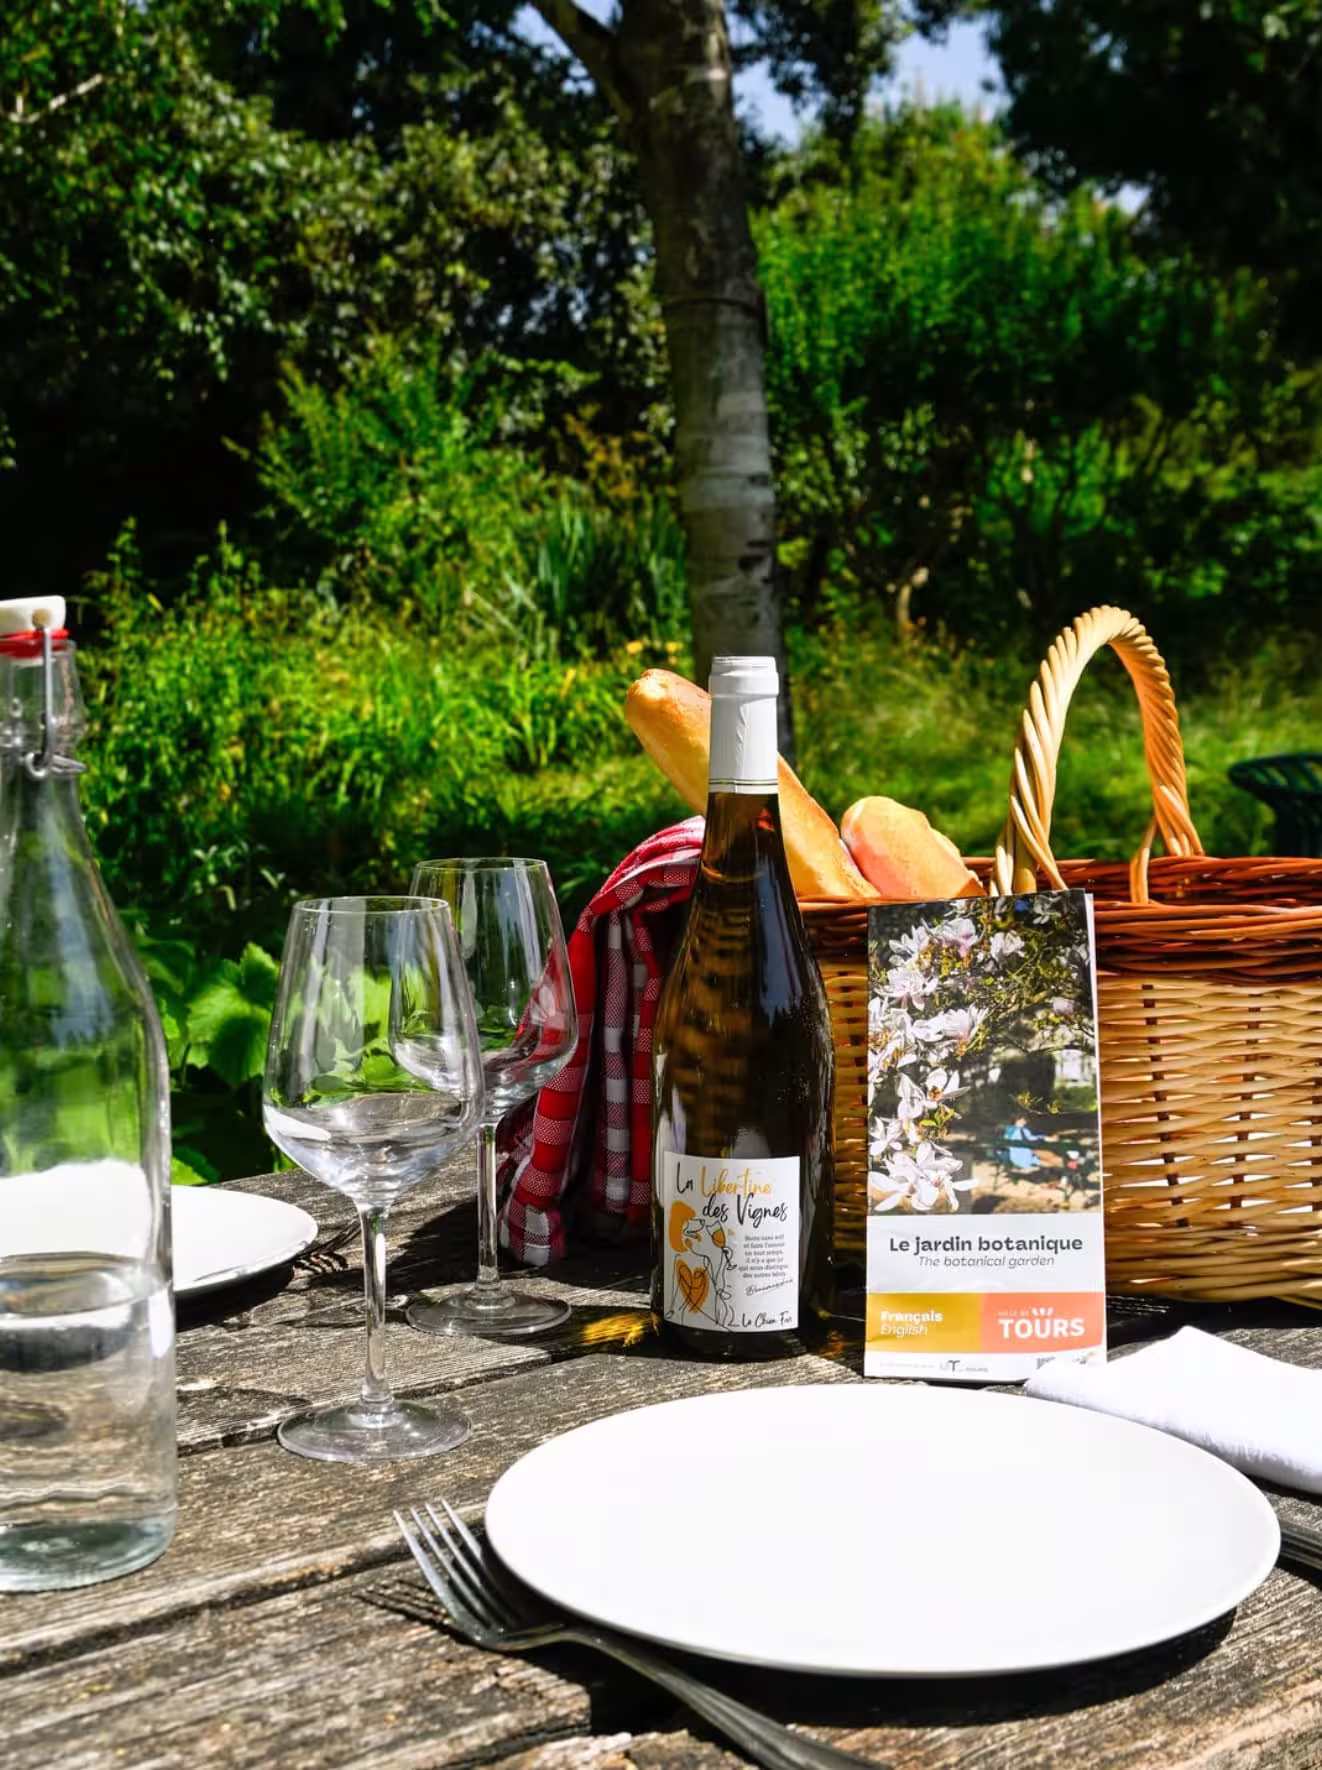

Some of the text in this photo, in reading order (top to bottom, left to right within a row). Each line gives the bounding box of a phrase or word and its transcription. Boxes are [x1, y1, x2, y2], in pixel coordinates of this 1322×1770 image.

[676, 1162, 772, 1199] La Libertine
[702, 1193, 789, 1229] des Vignes
[889, 1235, 1083, 1256] Le jardin botanique
[918, 1255, 1055, 1270] The botanical garden
[880, 1310, 943, 1324] Français
[880, 1324, 928, 1338] English
[998, 1318, 1085, 1339] TOURS
